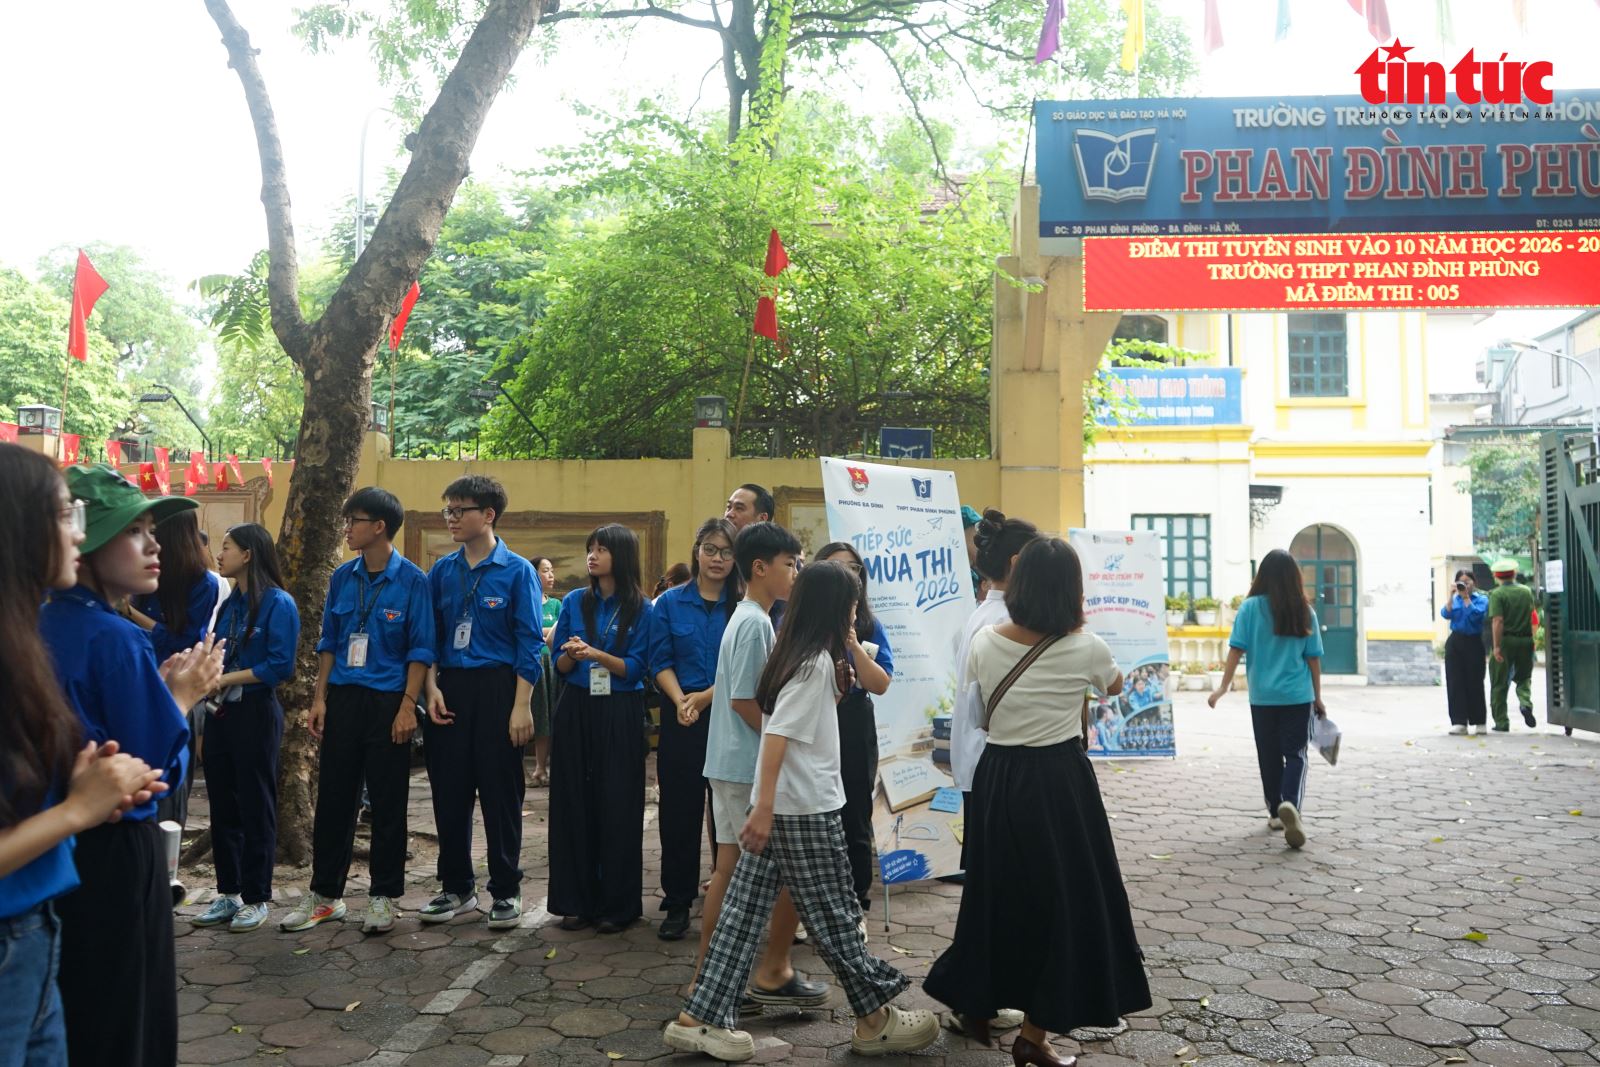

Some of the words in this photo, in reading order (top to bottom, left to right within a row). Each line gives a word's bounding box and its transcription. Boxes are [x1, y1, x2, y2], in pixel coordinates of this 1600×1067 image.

[1066, 110, 1086, 120] GIÁO
[1088, 110, 1104, 122] DỤC
[1108, 110, 1118, 119] VÀ
[1120, 110, 1137, 119] ĐÀO
[1140, 110, 1154, 120] TẠO
[1158, 109, 1169, 118] HÀ
[1172, 108, 1187, 120] NỘI
[1233, 102, 1327, 128] TRƯỜNG
[1334, 106, 1409, 126] TRUNG
[1416, 104, 1472, 128] HỌC
[1180, 147, 1333, 203] PHAN
[1343, 128, 1488, 200] ĐÌNH
[1055, 224, 1070, 234] ĐC:
[1072, 225, 1082, 234] 30
[1085, 224, 1108, 234] PHAN
[1110, 222, 1129, 234] ĐÌNH
[1132, 222, 1160, 234] PHÙNG
[1169, 224, 1180, 233] BA
[1184, 222, 1202, 232] ĐÌNH
[1210, 222, 1221, 232] HÀ
[1536, 218, 1550, 228] ĐT:
[1552, 218, 1573, 227] 0243
[1129, 238, 1181, 258] ĐIỂM
[1184, 241, 1219, 258] THI
[1222, 236, 1291, 257] TUYỂN
[1295, 240, 1343, 256] SINH
[1346, 236, 1390, 256] VÀO
[1395, 239, 1416, 255] 10
[1419, 236, 1468, 254] NĂM
[1472, 237, 1516, 256] HỌC
[1519, 236, 1562, 253] 2026
[1578, 236, 1600, 253] 20
[1207, 260, 1294, 280] TRƯỜNG
[1298, 263, 1350, 280] THPT
[1354, 262, 1408, 278] PHAN
[1412, 258, 1464, 278] ĐÌNH
[1469, 257, 1540, 277] PHÙNG
[1286, 282, 1320, 302] MÃ
[1322, 282, 1374, 302] ĐIỂM
[1378, 285, 1414, 302] THI
[1418, 288, 1423, 300] :
[1427, 284, 1459, 300] 005
[852, 526, 883, 552] TIẾP
[887, 524, 913, 549] SỨC
[864, 548, 913, 586] MÙA
[916, 546, 952, 580] THI
[916, 572, 959, 608] 2026
